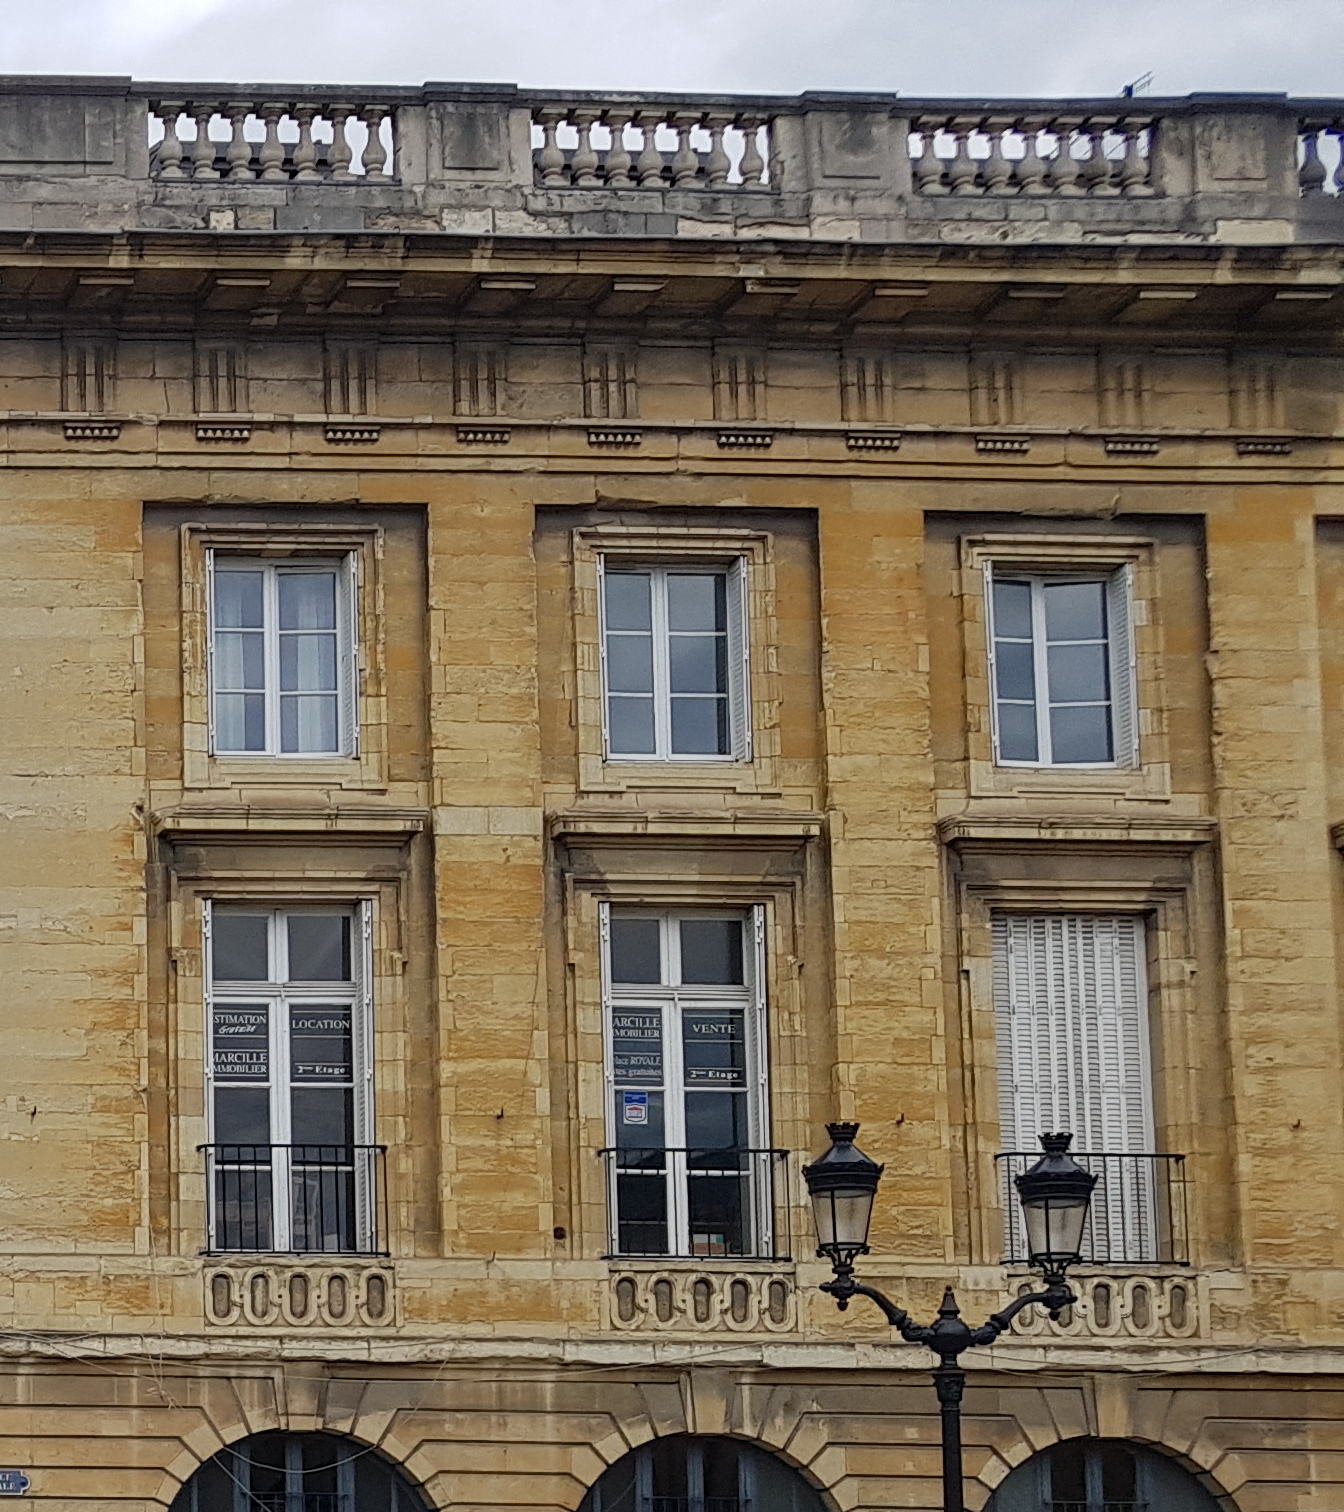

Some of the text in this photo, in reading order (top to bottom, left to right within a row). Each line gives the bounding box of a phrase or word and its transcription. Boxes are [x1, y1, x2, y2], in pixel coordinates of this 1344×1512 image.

[292, 1019, 351, 1030] LOCATION
[613, 1017, 661, 1028] ARCILLE
[692, 1024, 737, 1034] VENTE
[708, 1070, 739, 1080] Etage
